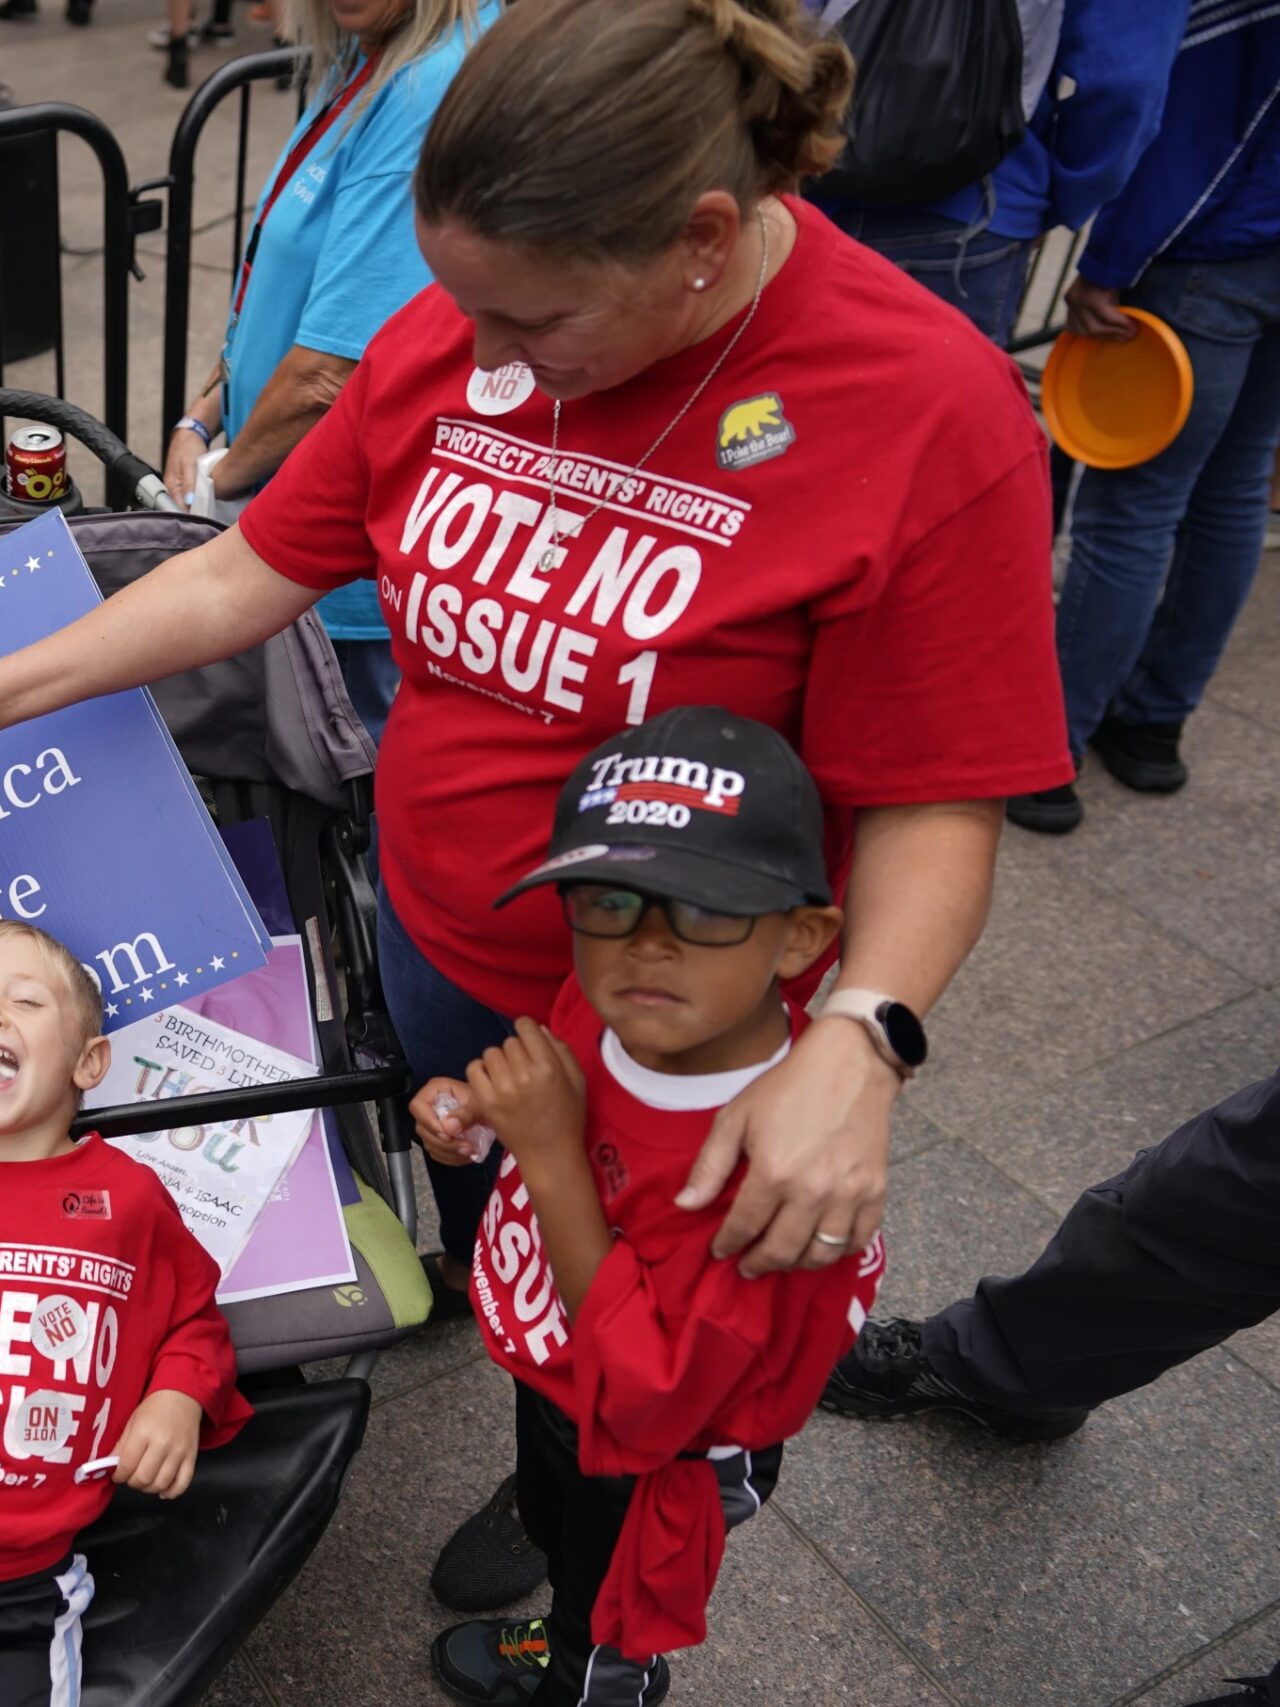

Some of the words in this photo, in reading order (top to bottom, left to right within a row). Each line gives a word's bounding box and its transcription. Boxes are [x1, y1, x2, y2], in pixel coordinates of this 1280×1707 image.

[480, 376, 519, 400] NO
[435, 424, 534, 473] PROTECT
[531, 459, 645, 504] PARENTS'
[646, 485, 746, 538] RIGHTS
[399, 466, 586, 604] VOTE
[564, 526, 703, 641] NO
[381, 575, 403, 613] ON
[405, 572, 599, 714] ISSUE
[618, 650, 658, 726] 1
[427, 661, 535, 716] November
[542, 710, 555, 725] 7
[586, 752, 746, 808] Trump
[606, 800, 692, 829] 2020
[154, 1012, 164, 1024] 3
[155, 1035, 216, 1072] SAVED
[215, 1065, 226, 1077] 3
[136, 1149, 159, 1164] Love
[194, 1190, 244, 1217] ISAAC
[80, 1259, 134, 1293] RIGHTS
[38, 1301, 72, 1326] VOTE
[43, 1316, 77, 1348] NO
[504, 1337, 517, 1353] 7
[28, 1406, 59, 1428] NO
[89, 1397, 112, 1463] 1
[24, 1428, 57, 1441] VOTE
[32, 1473, 47, 1489] 7
